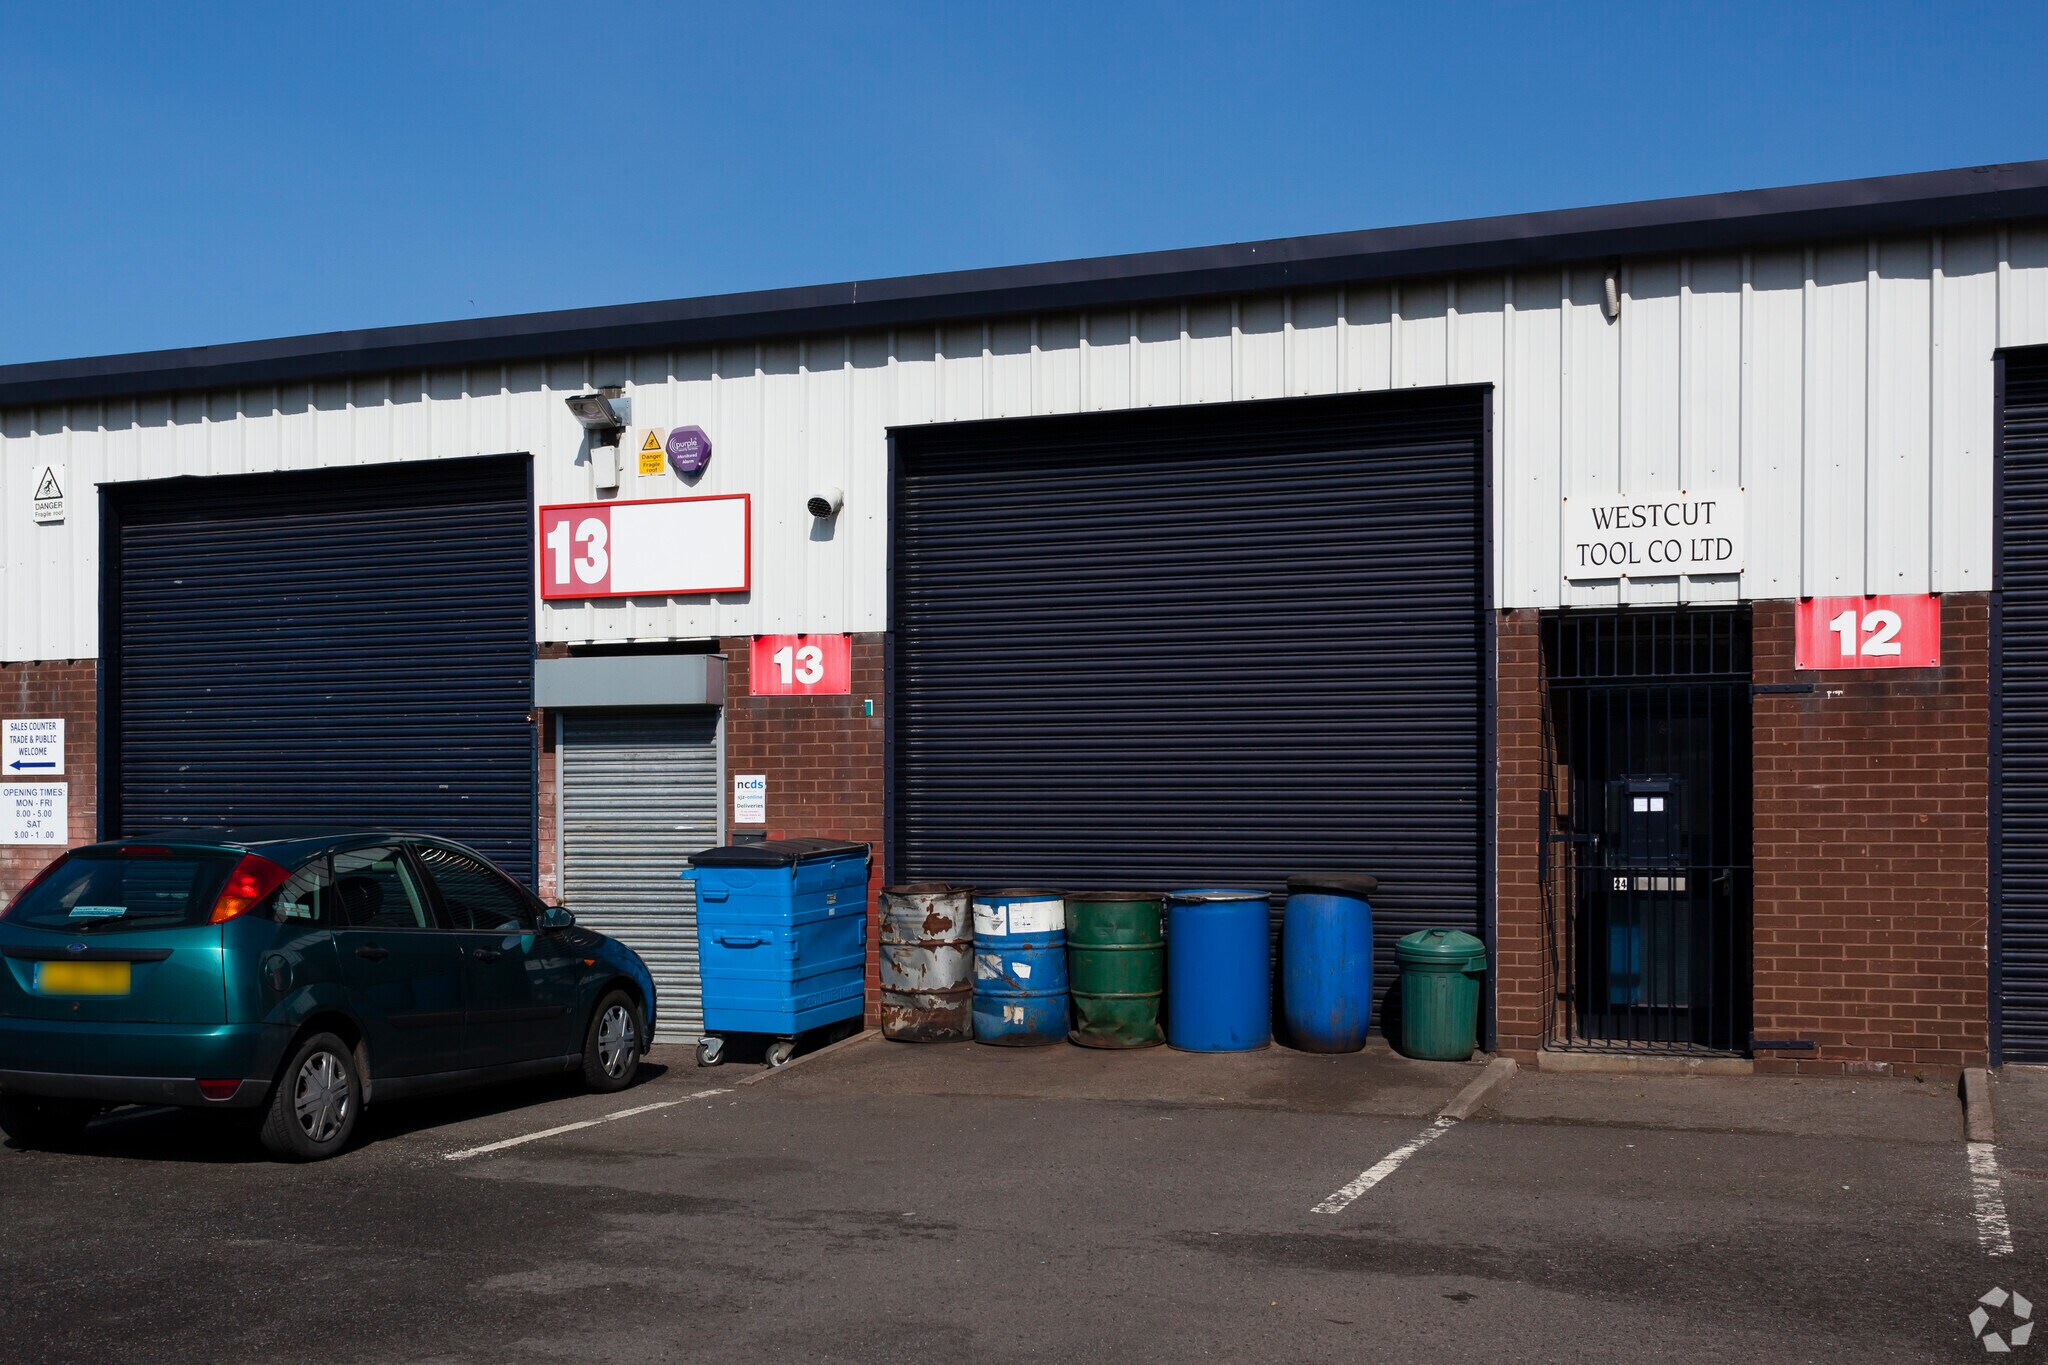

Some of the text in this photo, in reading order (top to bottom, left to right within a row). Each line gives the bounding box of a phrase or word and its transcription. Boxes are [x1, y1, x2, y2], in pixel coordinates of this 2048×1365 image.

[676, 438, 697, 450] purple
[35, 501, 63, 510] DANGER
[1592, 501, 1716, 530] WESTCUT
[547, 517, 608, 585] 13
[1576, 537, 1732, 566] TOOL CO LTD
[1829, 609, 1902, 656] 12
[774, 646, 824, 684] 13
[10, 722, 56, 731] SALES COUNTER
[10, 735, 56, 744] TRADE & PUBLIC
[18, 747, 47, 756] WELCOME
[737, 780, 764, 789] ncds
[3, 788, 38, 796] OPENING
[1614, 878, 1627, 889] 24
